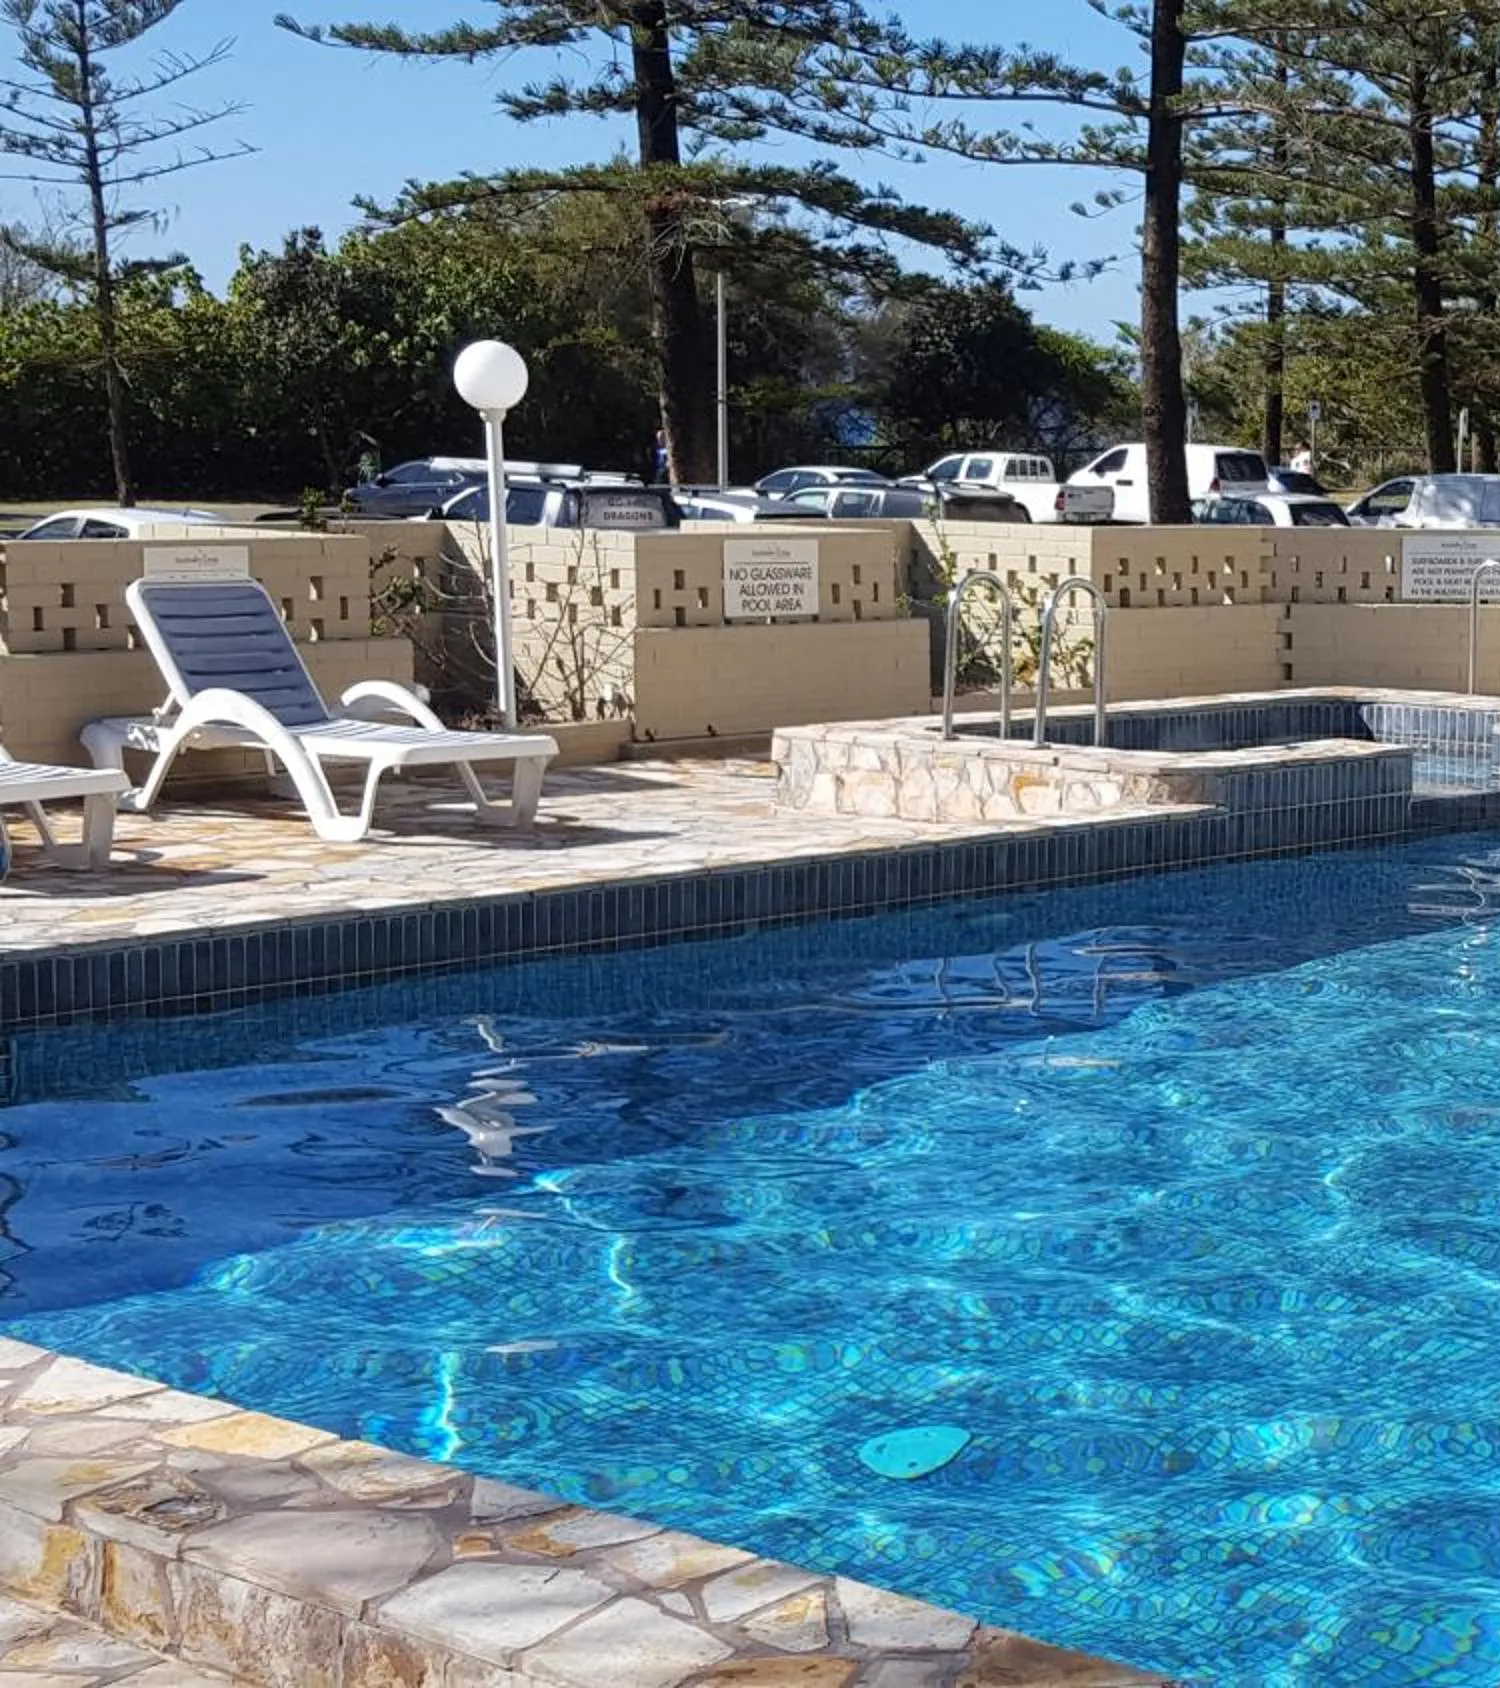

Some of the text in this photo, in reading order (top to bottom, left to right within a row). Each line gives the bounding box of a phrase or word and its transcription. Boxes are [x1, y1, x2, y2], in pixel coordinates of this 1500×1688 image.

[603, 511, 654, 521] DRAGONS
[729, 567, 812, 581] NO GLASSWARE
[740, 583, 804, 596] ALLOWED IN
[741, 598, 802, 611] POOL AREA
